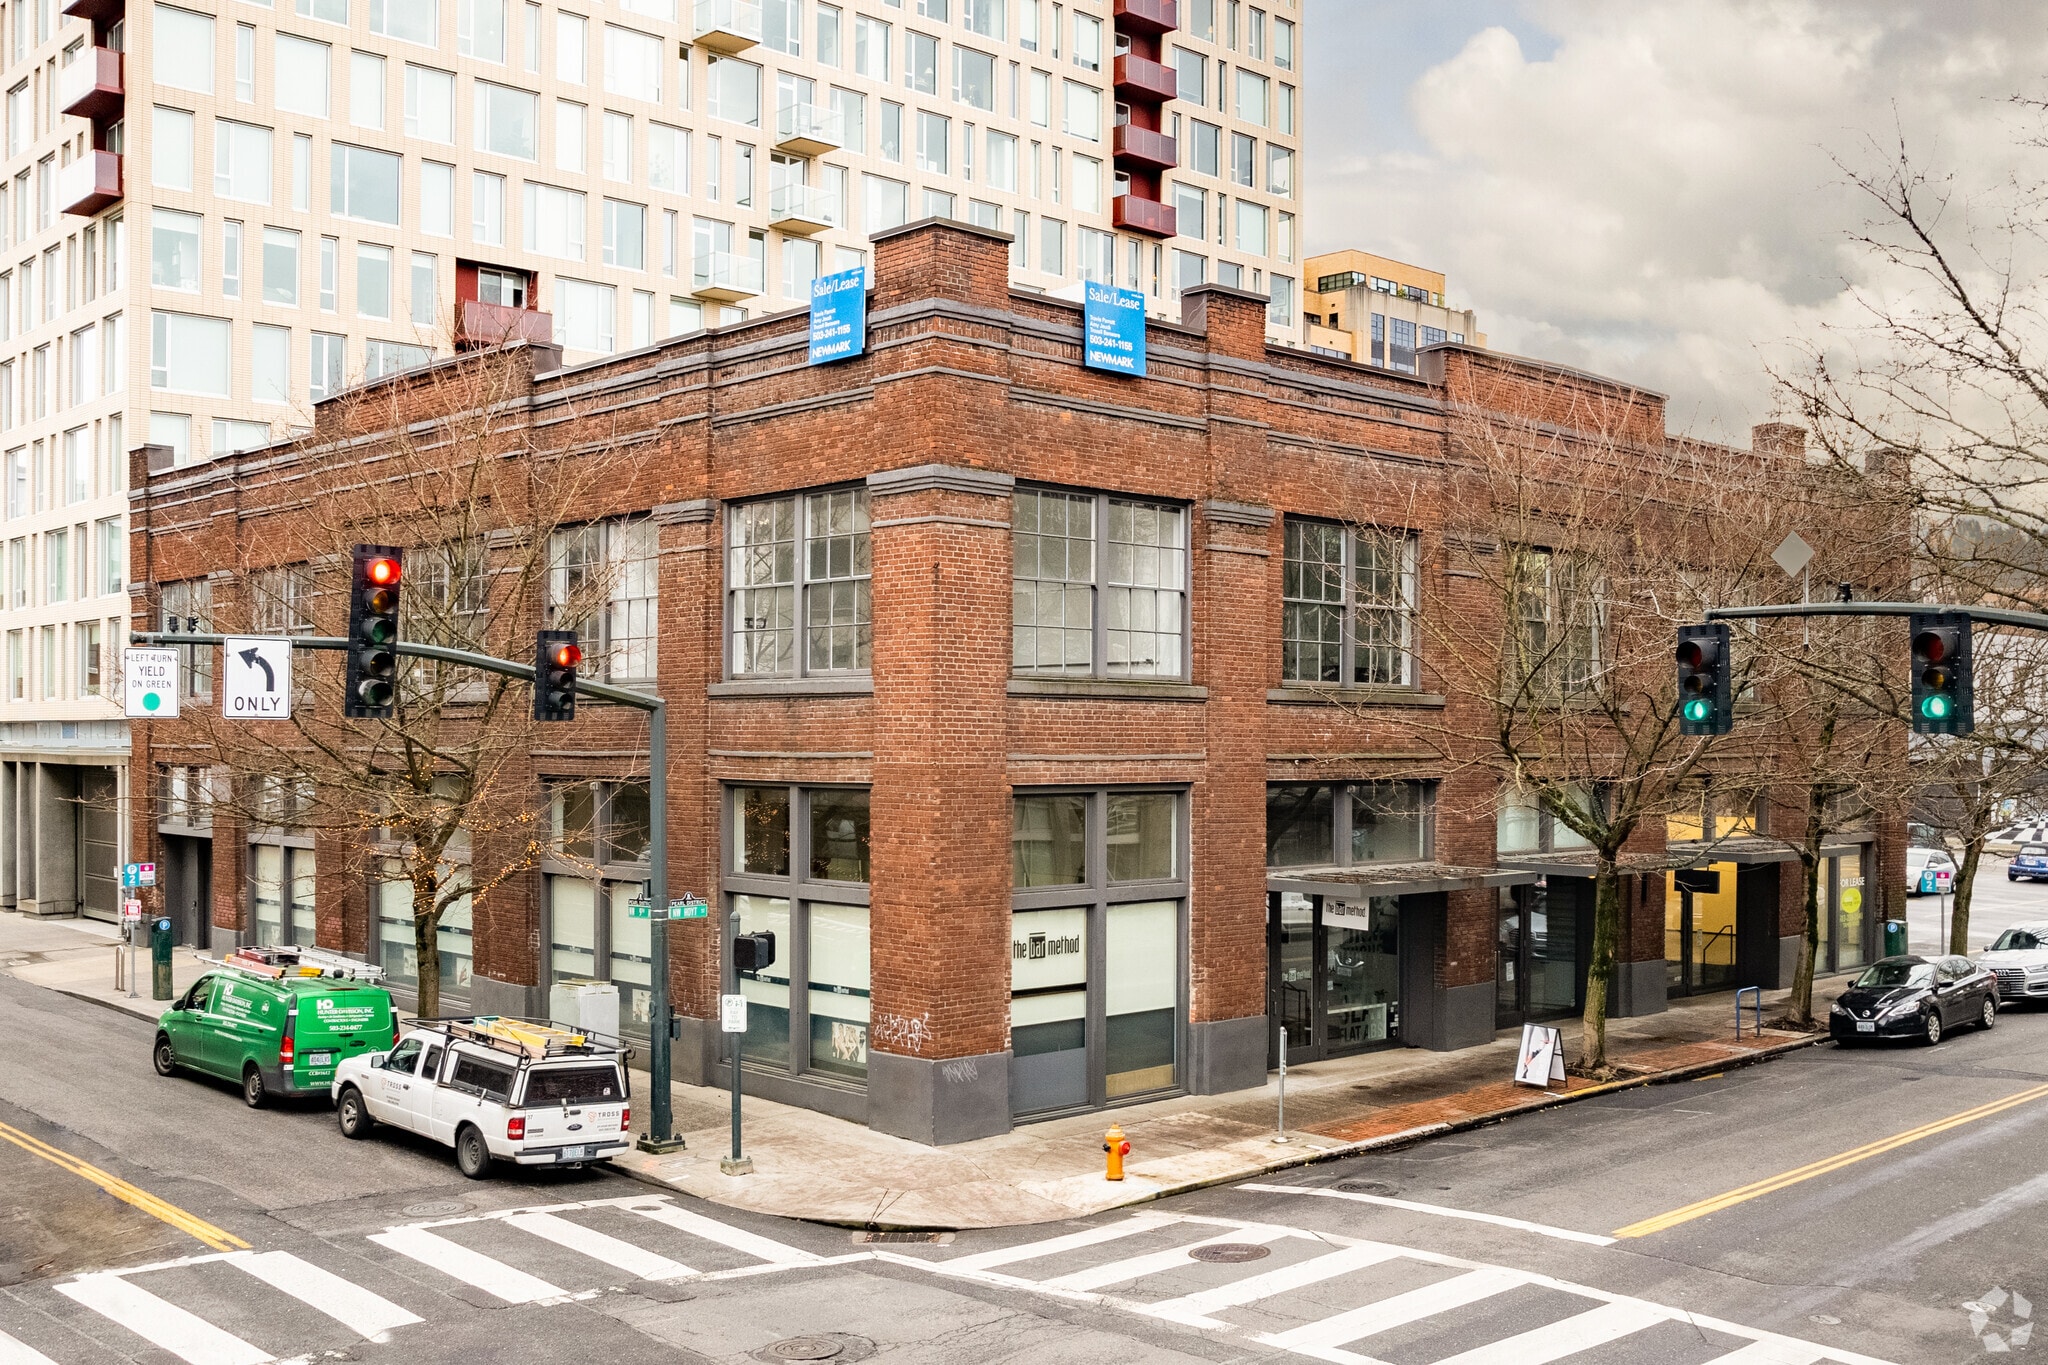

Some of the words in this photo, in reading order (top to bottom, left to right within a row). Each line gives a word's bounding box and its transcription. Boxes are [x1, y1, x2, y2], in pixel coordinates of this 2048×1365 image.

[814, 277, 859, 297] Sale/Lease
[1089, 288, 1140, 310] Sale/Lease
[813, 324, 850, 341] 503-241-1155
[1090, 335, 1132, 351] 503-241-1155
[812, 340, 850, 358] NEWMARK
[1090, 350, 1134, 368] NEWMARK
[130, 654, 149, 662] LEFT
[152, 654, 172, 663] TURN
[139, 666, 165, 677] YIELD
[132, 680, 143, 688] ON
[146, 680, 172, 688] GREEN
[234, 696, 281, 712] ONLY
[129, 875, 136, 884] 2
[1850, 876, 1865, 886] LEASE
[1926, 881, 1933, 890] 2
[672, 909, 681, 917] NW
[684, 907, 697, 916] HOYT
[1325, 902, 1334, 913] the
[1013, 939, 1027, 958] the
[1048, 934, 1079, 955] method
[316, 999, 334, 1010] HD
